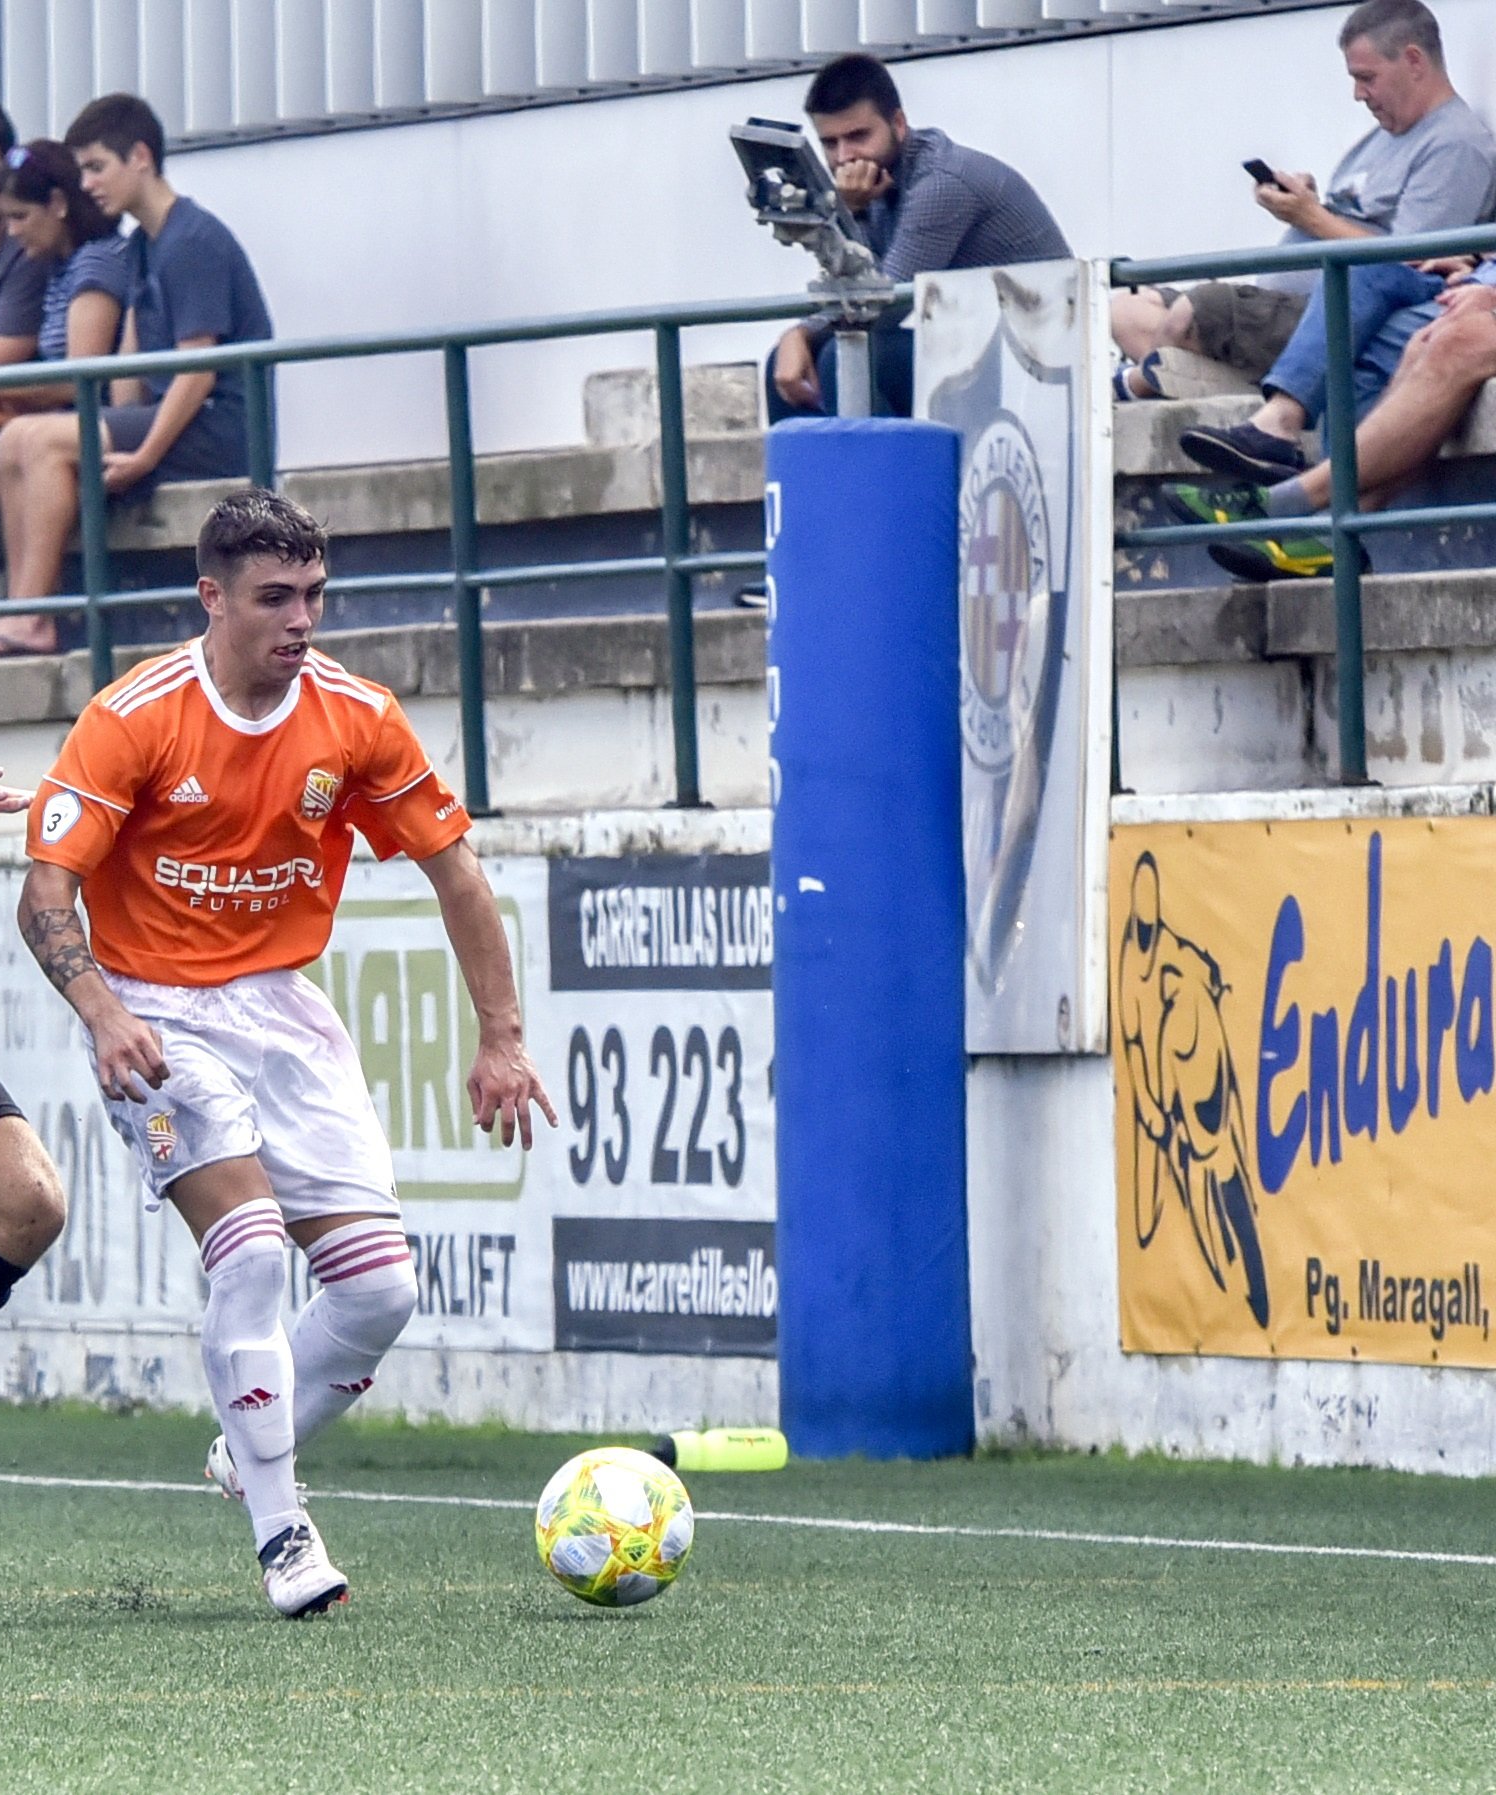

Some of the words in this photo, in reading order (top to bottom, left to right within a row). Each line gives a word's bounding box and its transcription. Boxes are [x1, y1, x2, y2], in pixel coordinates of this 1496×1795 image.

[168, 792, 210, 804] adidas
[189, 893, 291, 913] FUTBOL
[579, 886, 716, 969] CARRETILLAS
[1256, 830, 1496, 1195] Endura
[567, 1024, 631, 1187] 93
[648, 1024, 747, 1189] 223
[1305, 1256, 1350, 1337] Pg.
[1358, 1258, 1490, 1342] Maragall,
